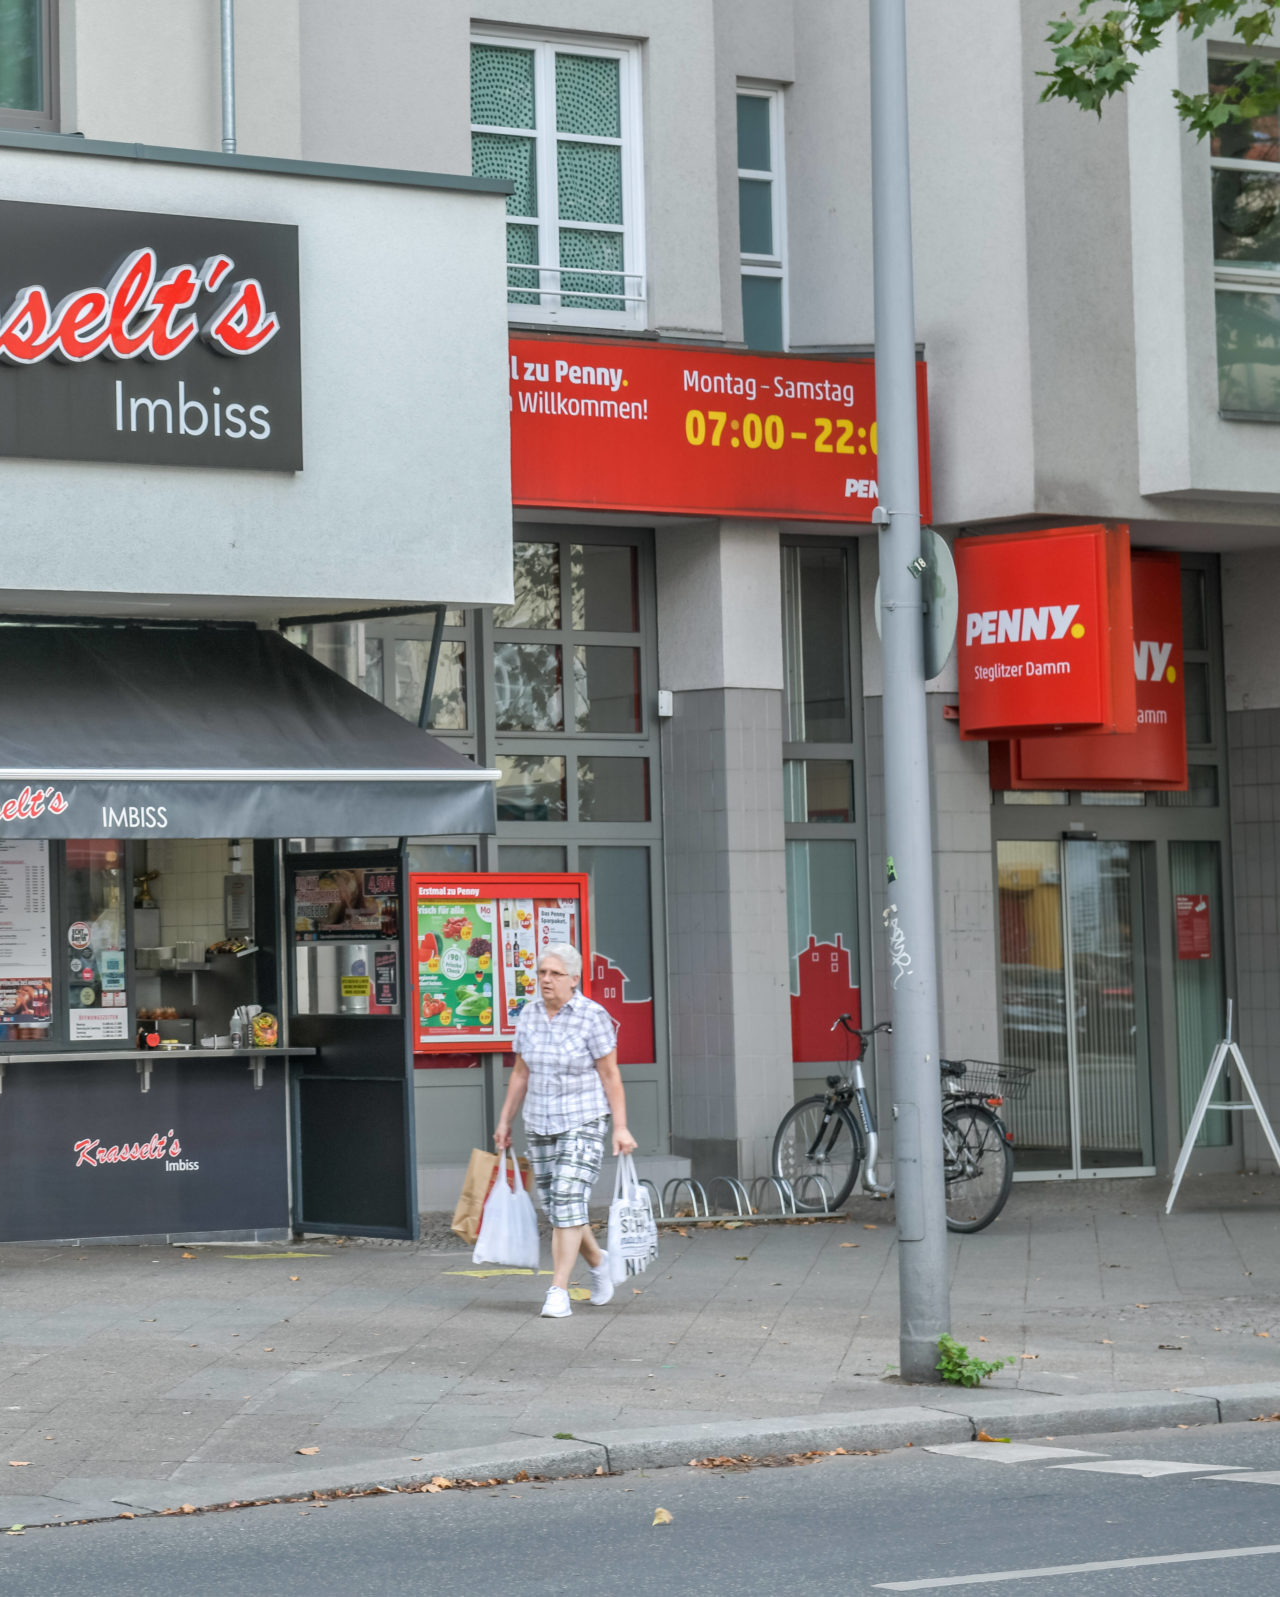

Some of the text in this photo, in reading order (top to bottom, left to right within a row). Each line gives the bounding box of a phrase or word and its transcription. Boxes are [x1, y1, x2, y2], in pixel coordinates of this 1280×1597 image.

[523, 362, 549, 382] zu
[555, 360, 629, 392] Penny.
[683, 370, 756, 400] Montag
[773, 376, 854, 407] Samstag
[114, 380, 272, 439] Imbiss
[518, 390, 648, 420] Willkommen!
[685, 409, 785, 450] 07:00
[844, 478, 879, 499] PEN
[974, 661, 1071, 682] Steglitzer Damm
[1137, 708, 1168, 724] amm
[102, 806, 168, 828] IMBISS
[418, 887, 446, 896] Erstmal
[457, 887, 480, 897] Penny
[74, 1129, 182, 1167] Krasselt's
[165, 1159, 200, 1171] Imbiss
